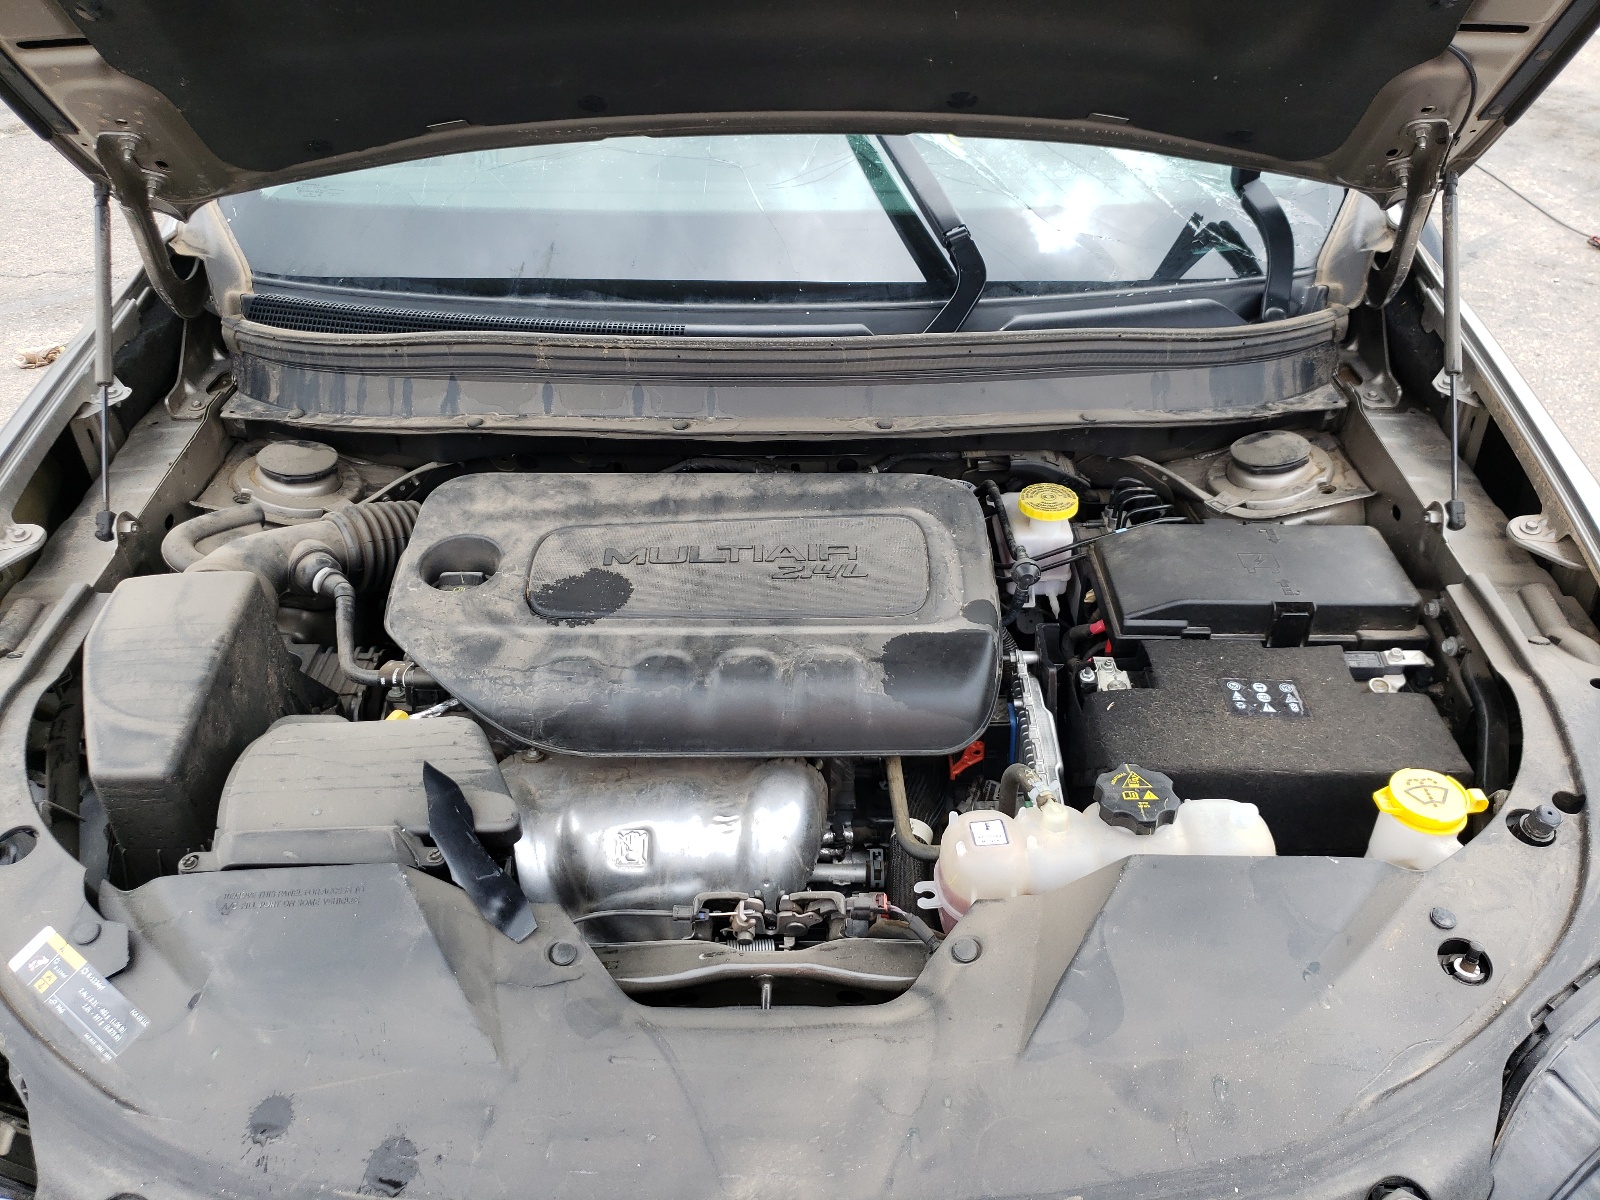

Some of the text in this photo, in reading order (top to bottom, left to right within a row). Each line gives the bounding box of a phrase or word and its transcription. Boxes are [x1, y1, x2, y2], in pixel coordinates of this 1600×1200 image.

[603, 544, 858, 566] MULTIAIR
[224, 891, 257, 900] REMOVE
[258, 890, 276, 899] THIS
[277, 888, 302, 898] PANEL
[304, 888, 320, 896] FOR
[221, 901, 238, 910] A/C
[240, 900, 256, 910] FILL
[259, 899, 282, 909] PORT
[283, 899, 296, 908] ON
[299, 898, 320, 907] SOME
